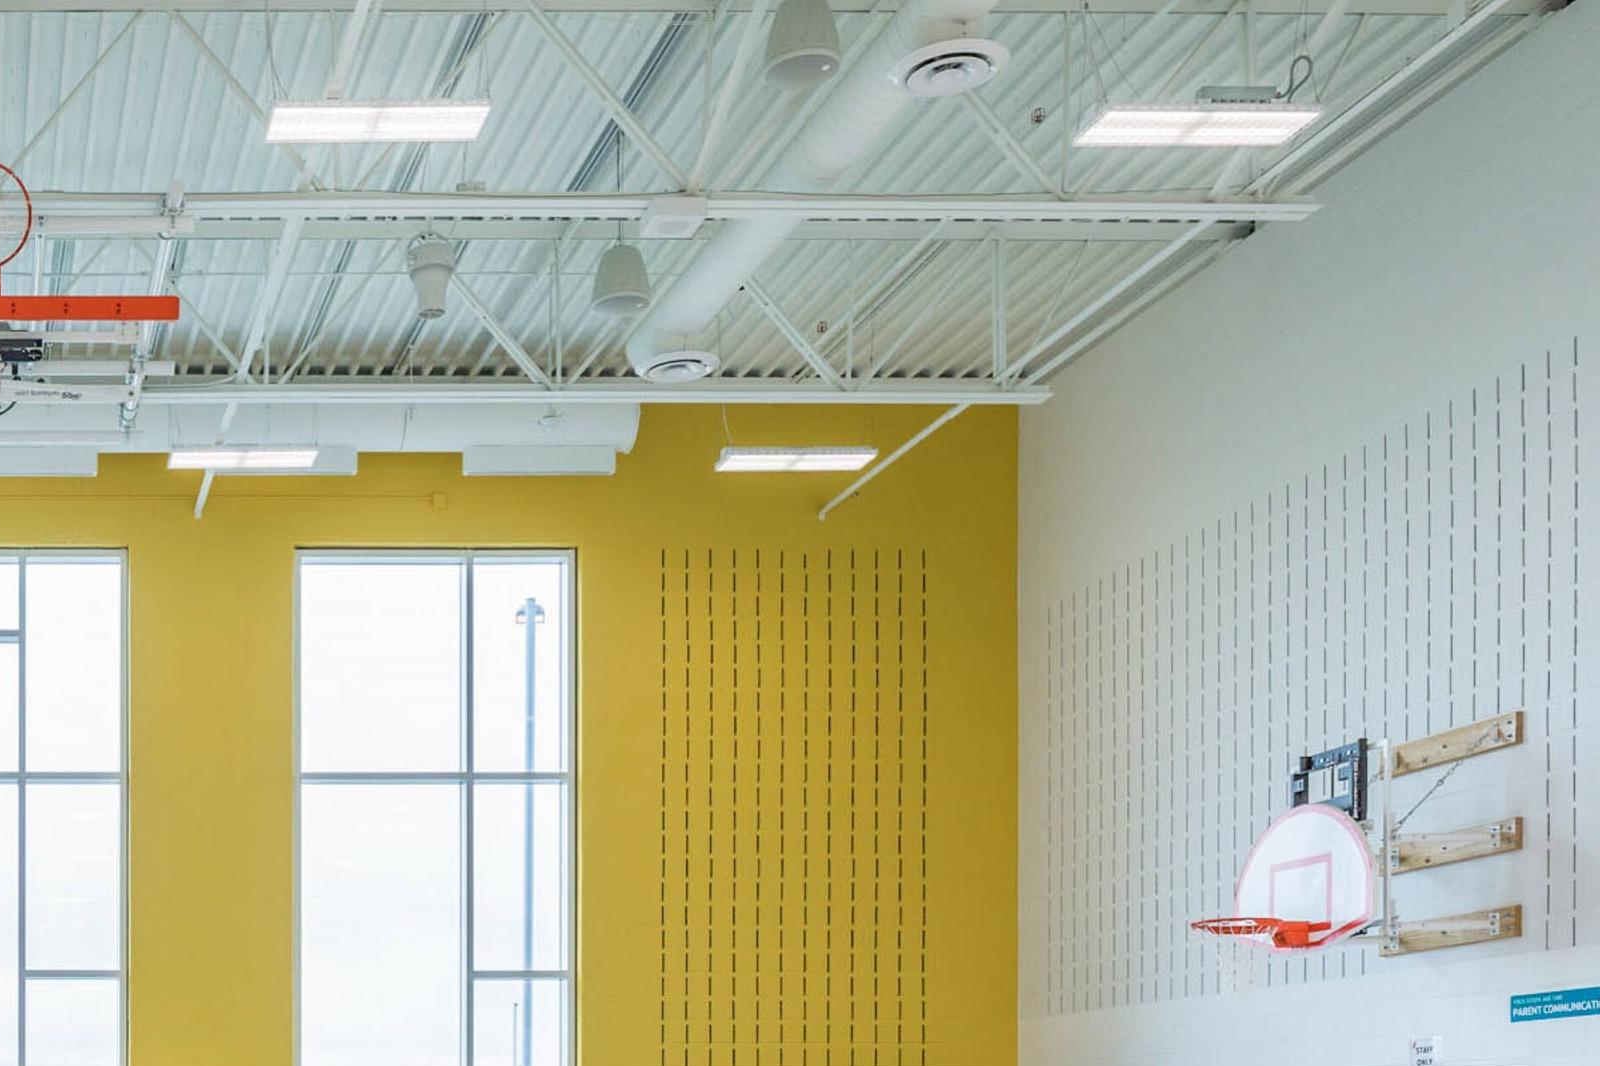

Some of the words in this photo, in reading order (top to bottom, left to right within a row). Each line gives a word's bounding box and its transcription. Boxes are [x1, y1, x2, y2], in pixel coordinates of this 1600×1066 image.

[1512, 1005, 1542, 1017] PARENT
[1416, 1045, 1433, 1055] STAFF
[1416, 1058, 1433, 1066] ONLY
